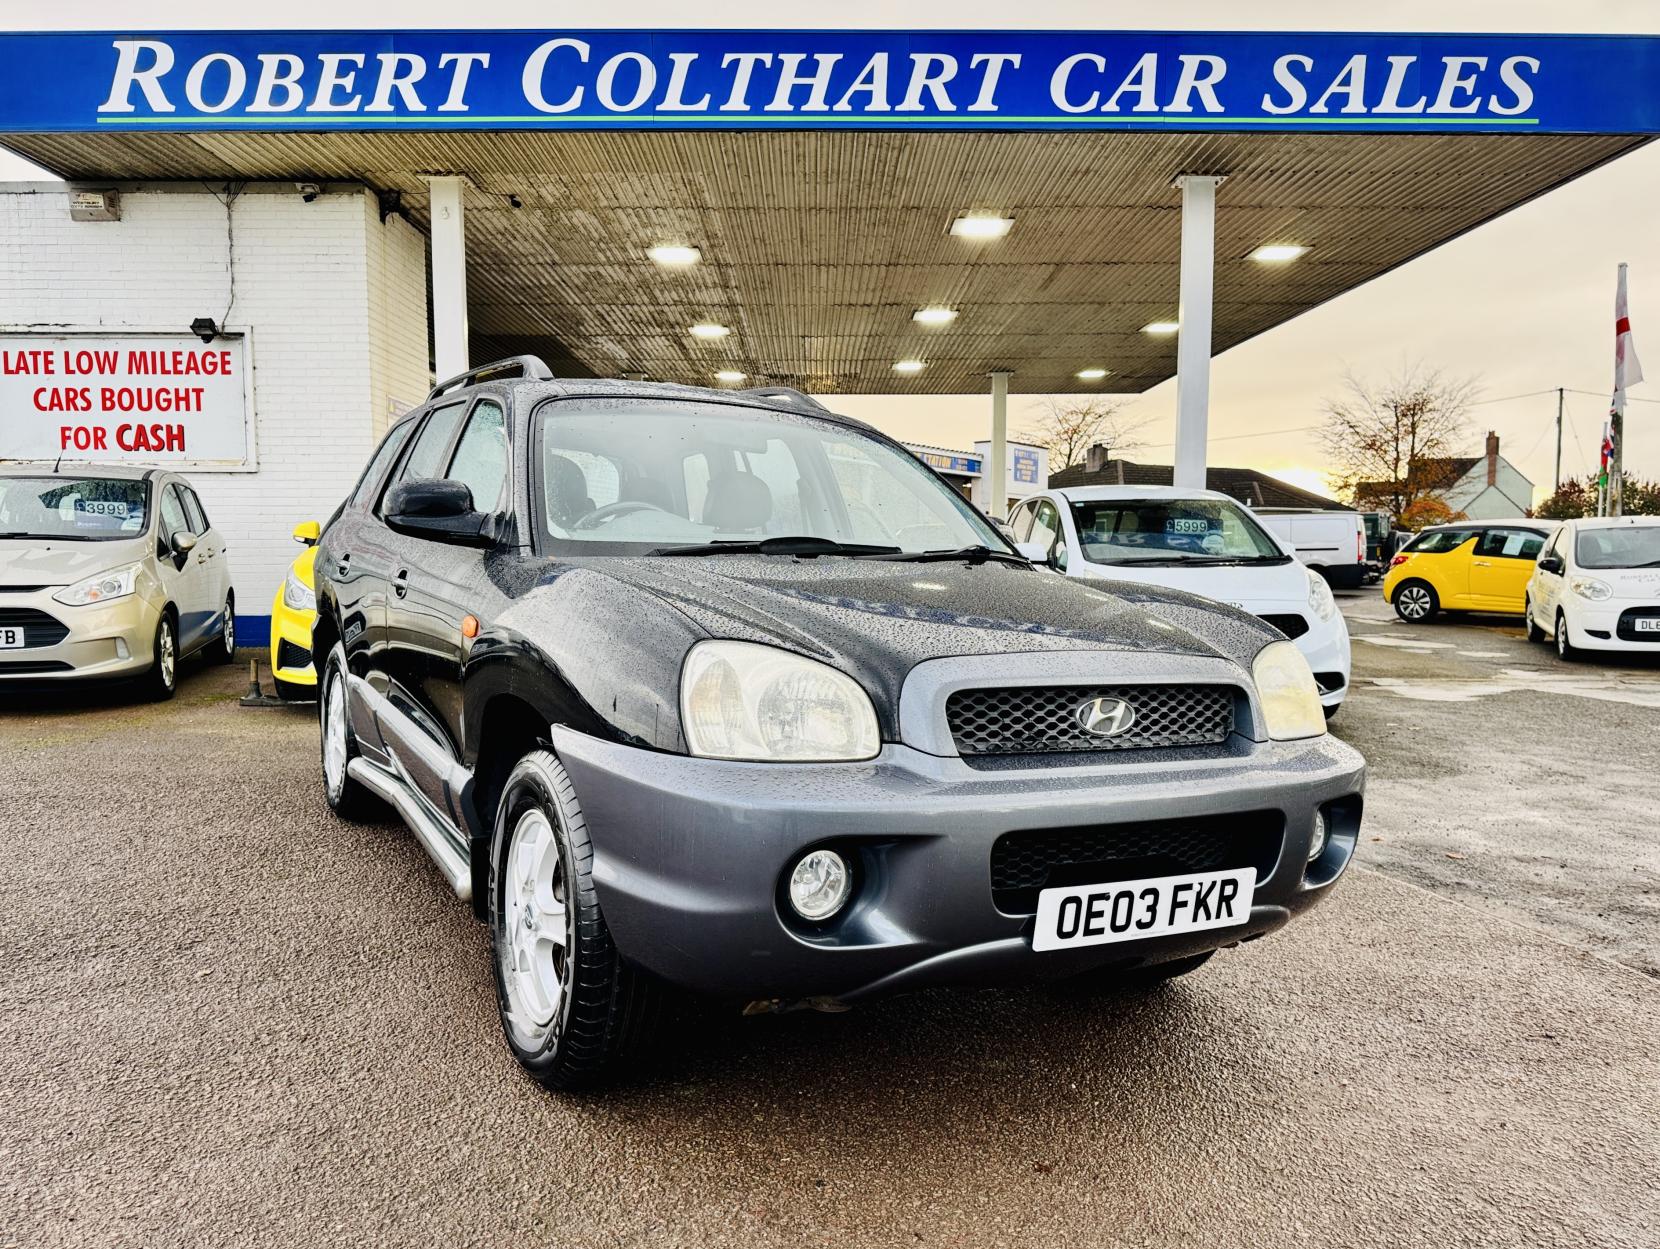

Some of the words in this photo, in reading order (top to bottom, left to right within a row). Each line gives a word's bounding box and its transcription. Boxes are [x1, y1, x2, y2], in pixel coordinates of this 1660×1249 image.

[97, 40, 490, 114] ROBERT
[522, 38, 1021, 113] COLTHART
[1050, 53, 1227, 113] CAR
[1261, 54, 1541, 115] SALES
[3, 350, 55, 375] LATE
[64, 350, 118, 375] LOW
[127, 350, 231, 375] MILEAGE
[33, 387, 92, 412] CARS
[101, 387, 204, 412] BOUGHT
[60, 426, 107, 451] FOR
[115, 423, 185, 452] CASH
[1056, 887, 1160, 940] OE03
[1168, 878, 1239, 927] FKR
